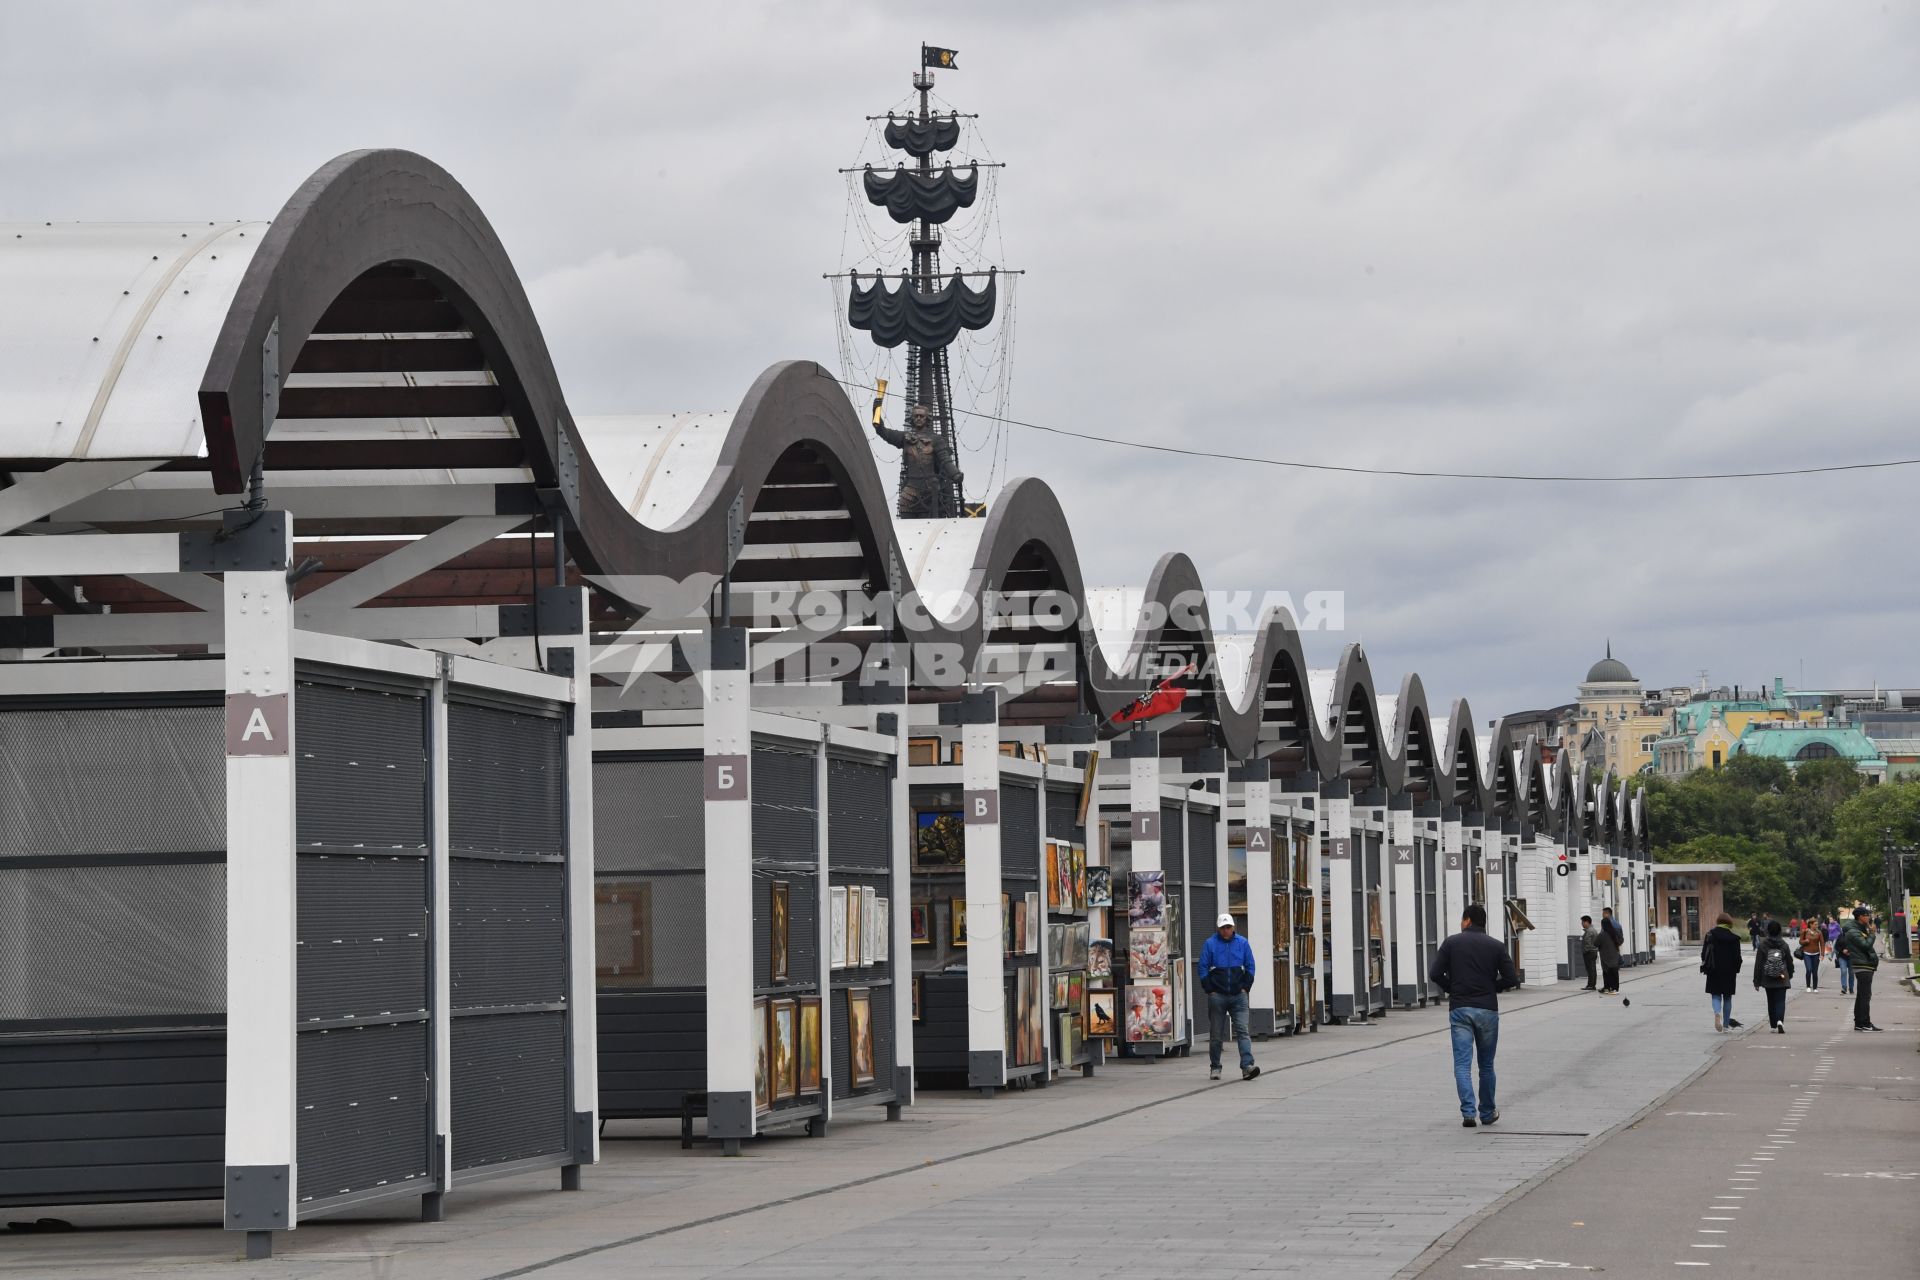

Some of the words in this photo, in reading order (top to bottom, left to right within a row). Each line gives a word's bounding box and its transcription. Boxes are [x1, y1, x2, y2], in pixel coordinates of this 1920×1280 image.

[241, 708, 272, 741] А
[719, 766, 735, 788] Б
[976, 798, 987, 817] В
[1141, 818, 1150, 834] Г
[1251, 832, 1265, 847] Д
[1336, 843, 1344, 855] Е
[1398, 850, 1410, 860] Ж
[1490, 862, 1498, 870] И
